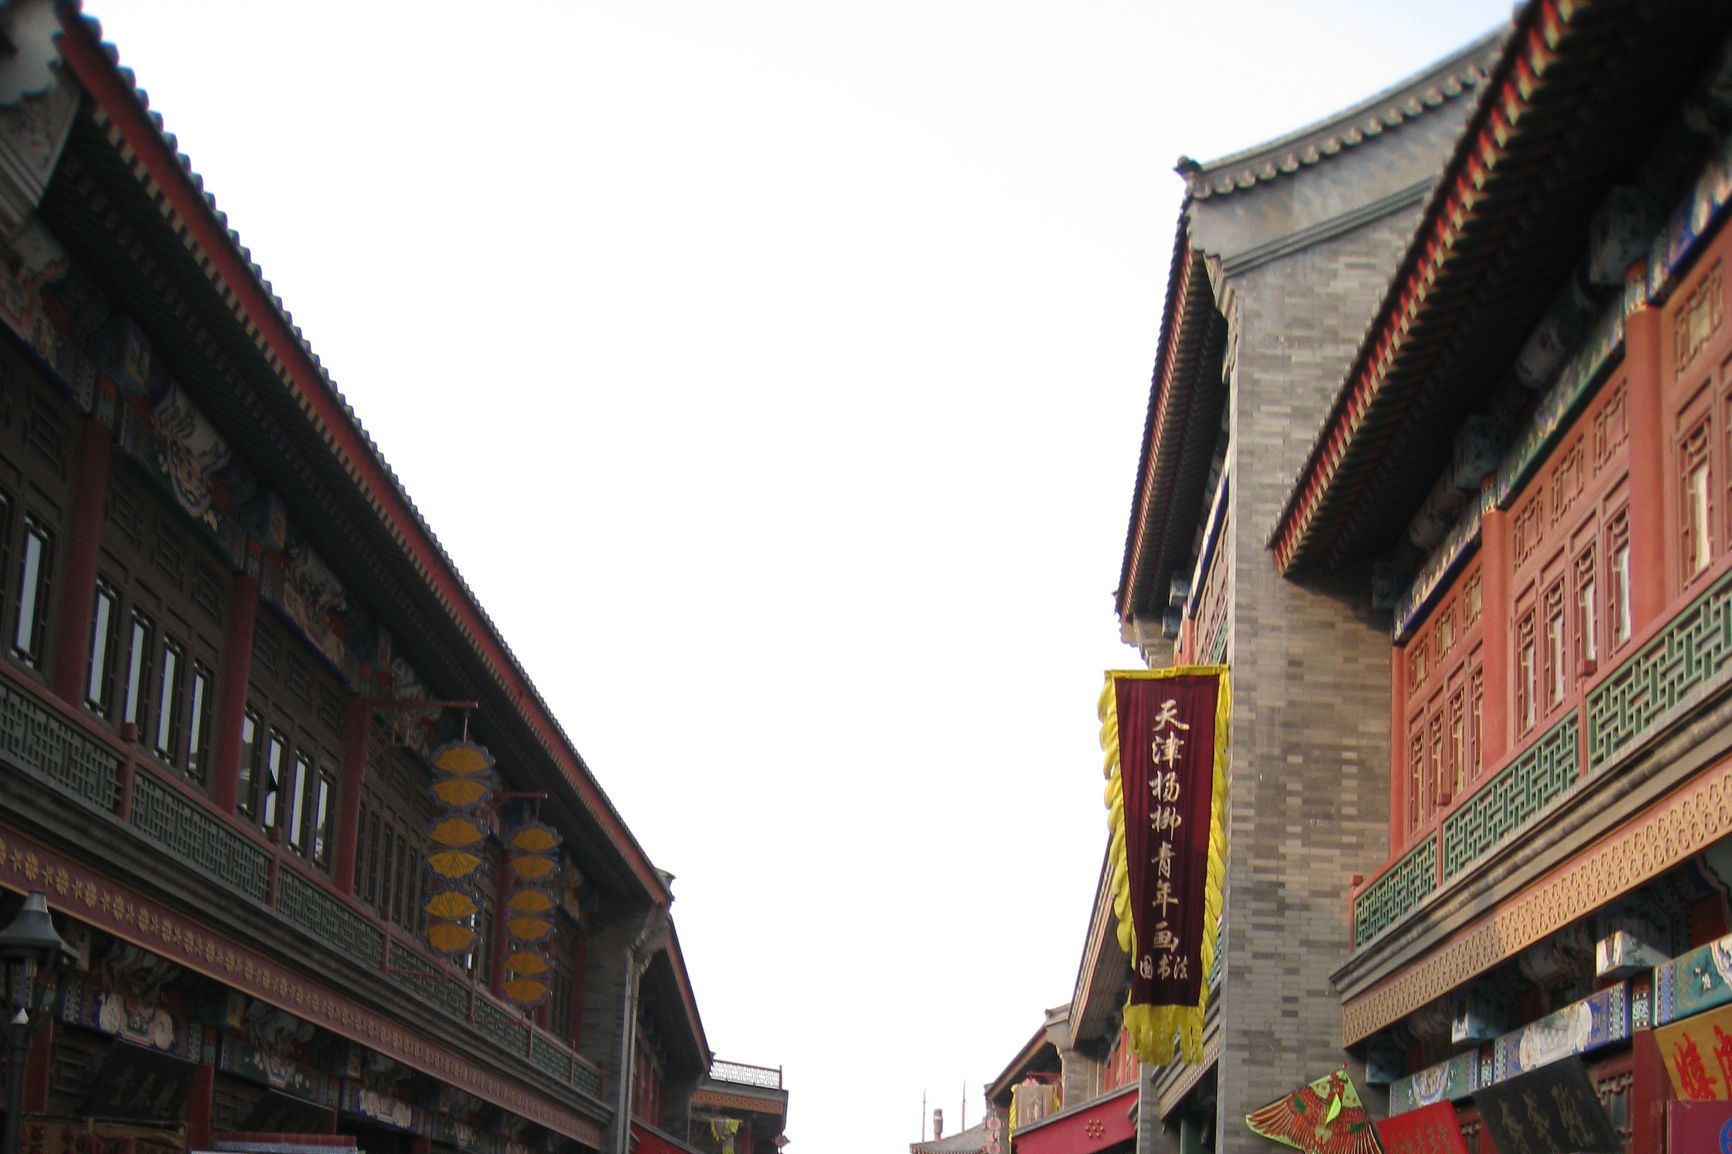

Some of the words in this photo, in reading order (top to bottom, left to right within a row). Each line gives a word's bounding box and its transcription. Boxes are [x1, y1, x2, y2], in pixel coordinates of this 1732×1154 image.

[1148, 699, 1190, 952] 天津杨柳青年画
